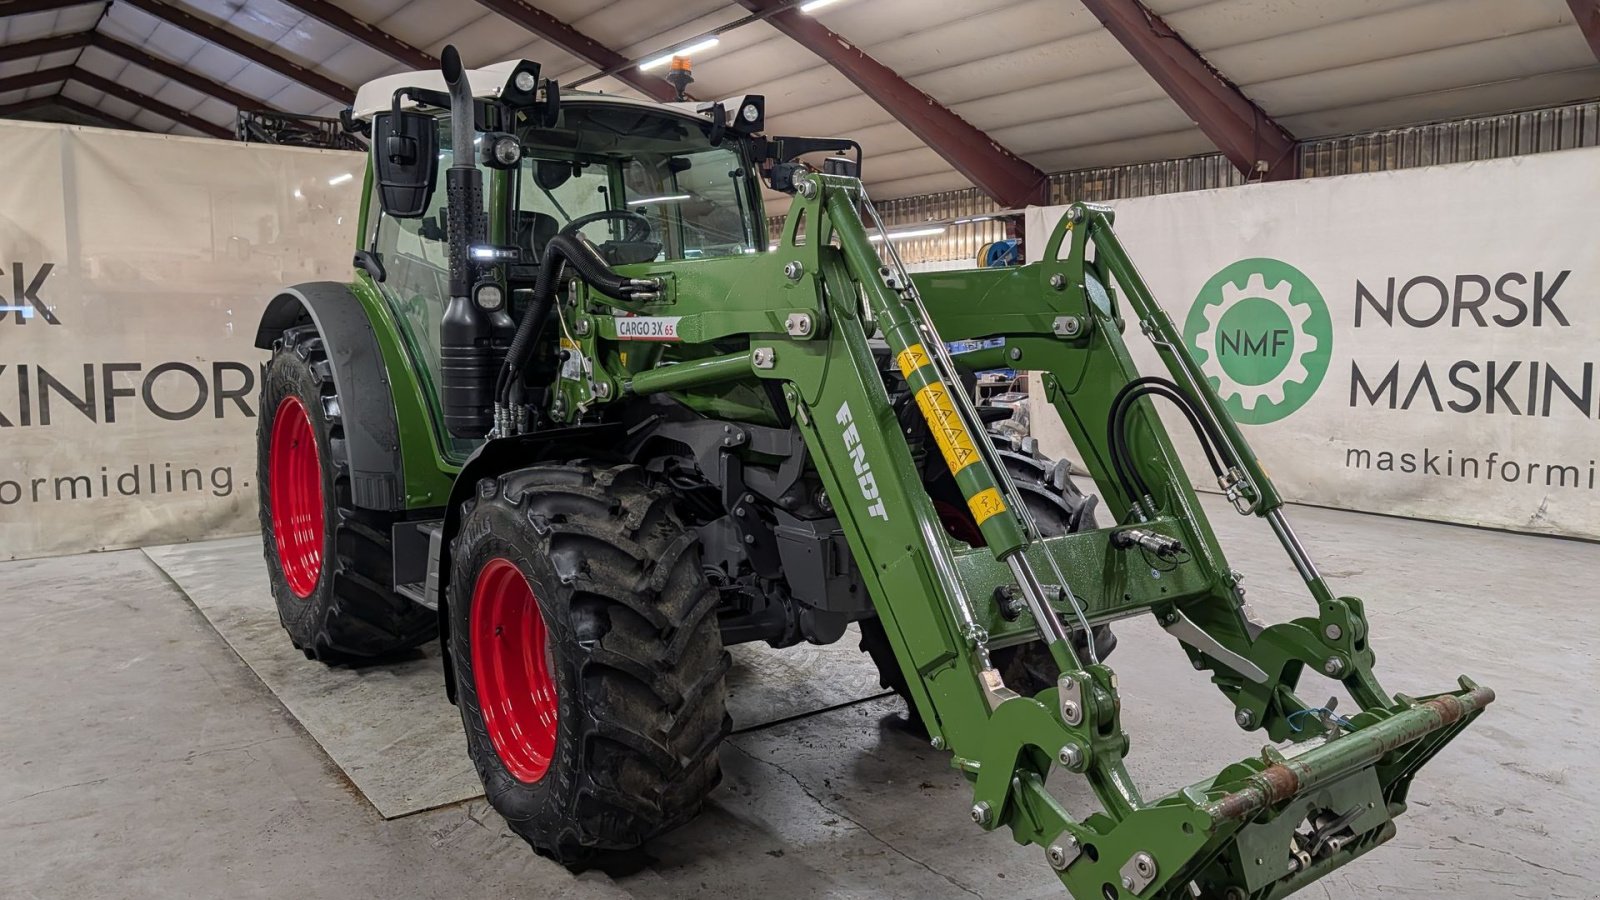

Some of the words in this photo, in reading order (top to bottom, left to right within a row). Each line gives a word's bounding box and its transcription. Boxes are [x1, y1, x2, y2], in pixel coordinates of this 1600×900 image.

[1354, 270, 1571, 328] NORSK
[619, 321, 650, 336] CARGO
[651, 322, 663, 336] 3X
[664, 325, 674, 336] 65
[1221, 329, 1289, 358] NMF
[0, 361, 268, 427] INFOR
[1350, 360, 1600, 419] MASKIN
[835, 400, 889, 521] FENDT
[1347, 448, 1596, 489] maskinformi
